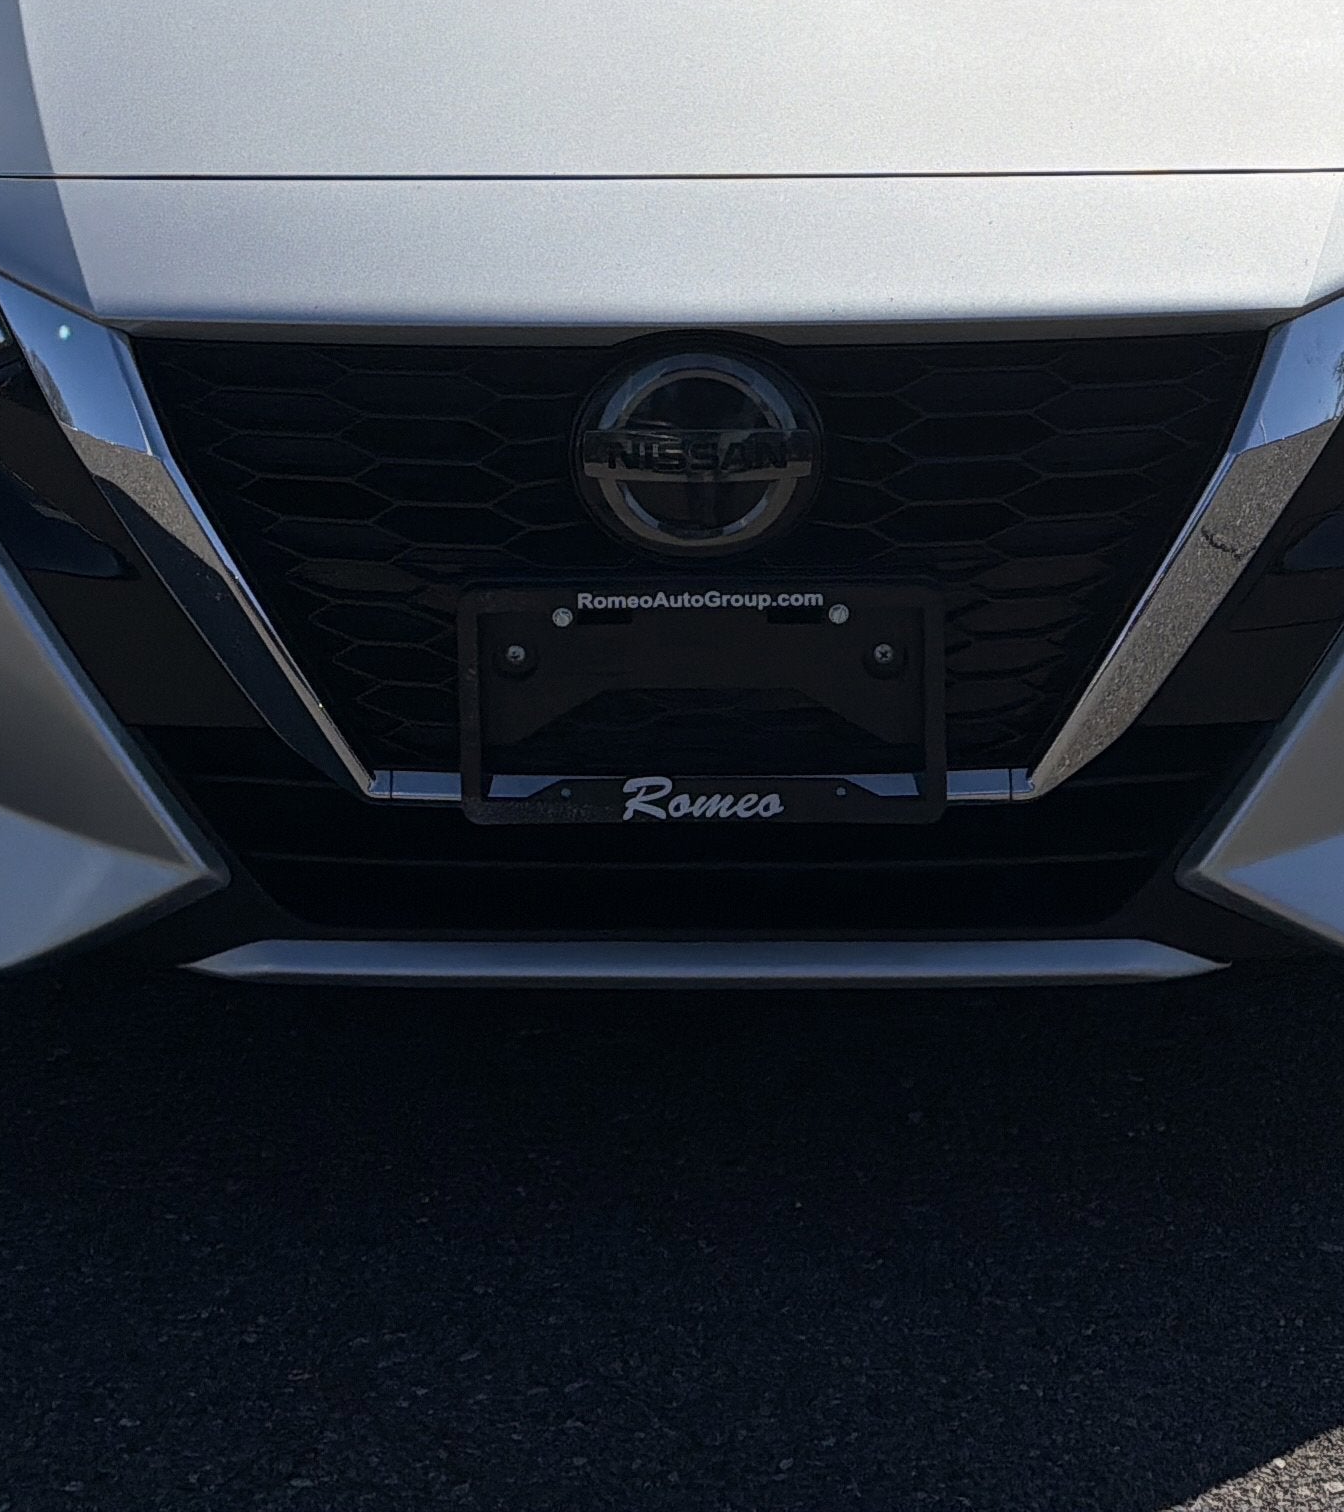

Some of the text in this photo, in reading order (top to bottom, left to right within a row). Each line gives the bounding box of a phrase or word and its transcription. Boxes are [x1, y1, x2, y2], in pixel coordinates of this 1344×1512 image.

[607, 440, 788, 471] NISSAN
[577, 591, 824, 610] RomeoAutoGroup.com
[622, 776, 784, 820] Romeo
